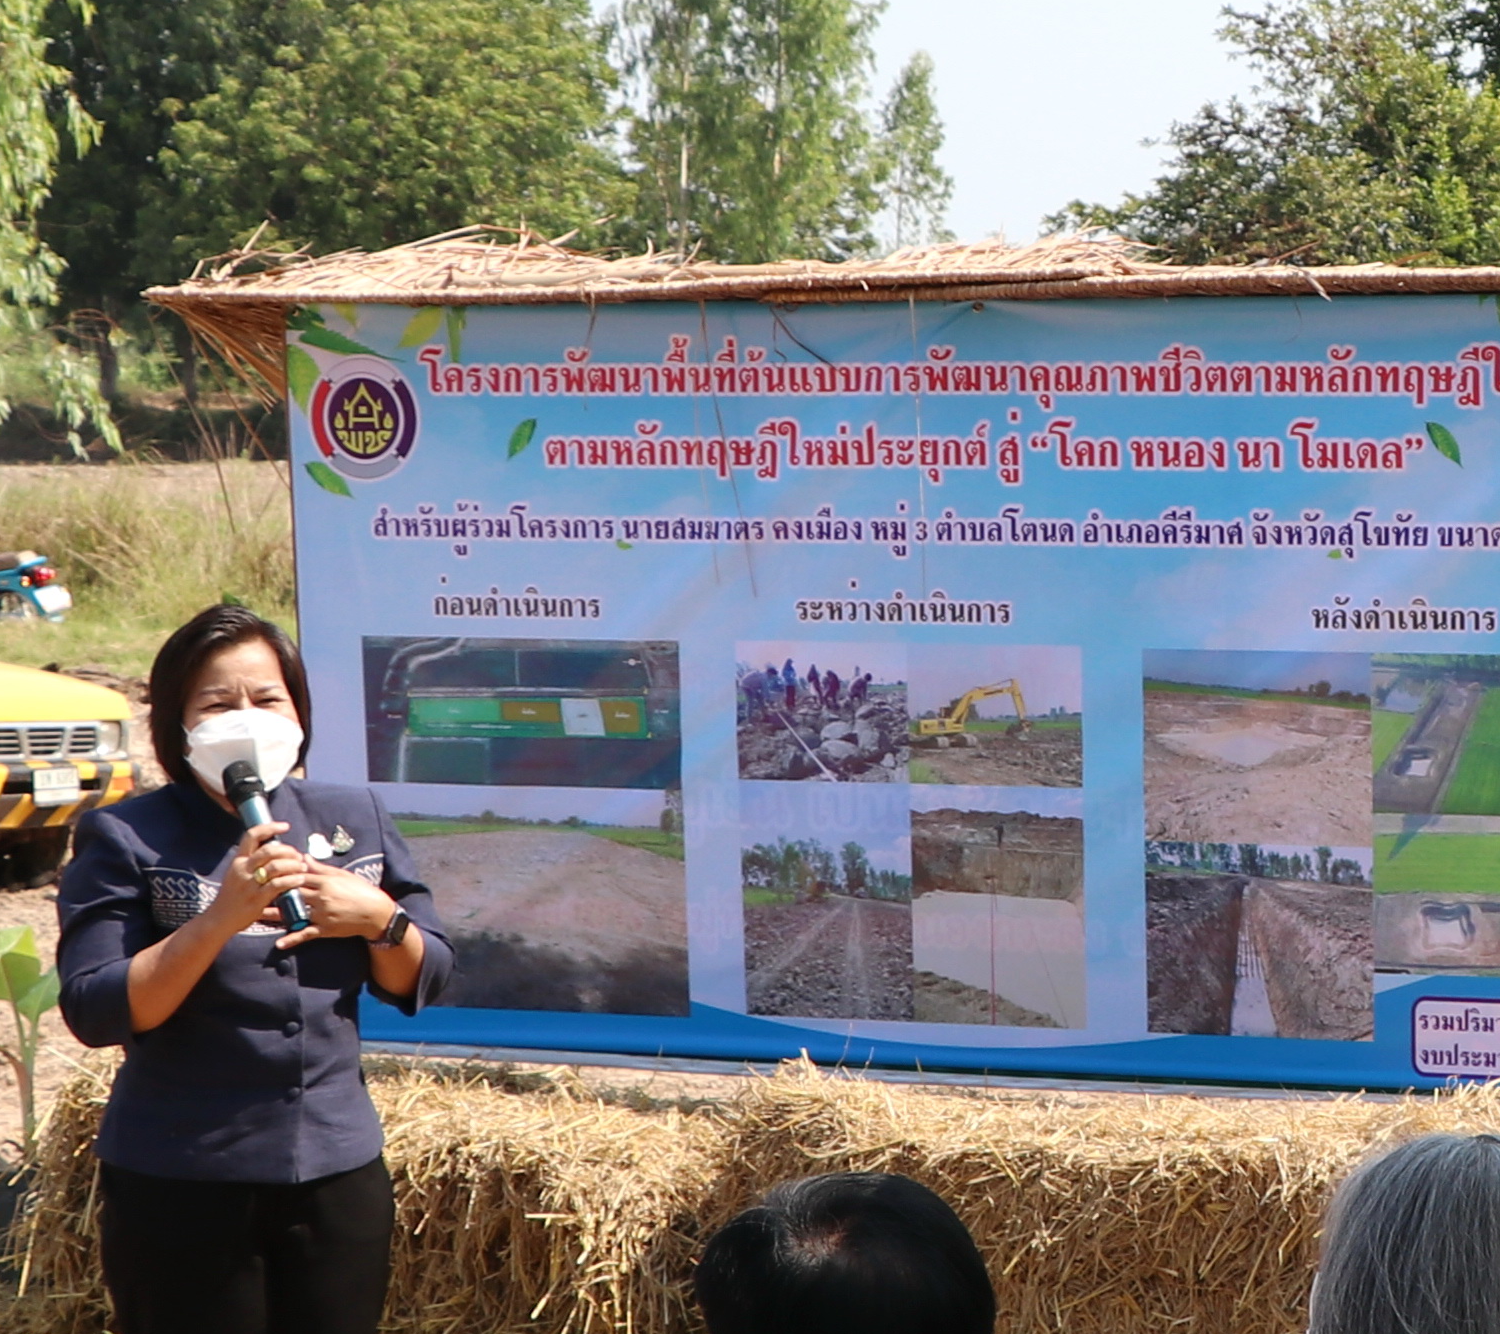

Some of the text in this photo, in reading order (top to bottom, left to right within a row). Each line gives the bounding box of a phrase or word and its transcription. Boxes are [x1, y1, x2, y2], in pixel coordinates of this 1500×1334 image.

[545, 421, 987, 482] ตามหลักทฤษฎีใหม่ประยุกต์
[999, 412, 1021, 483] สู่
[1132, 437, 1225, 468] หนอง
[1238, 438, 1282, 469] นา
[373, 503, 614, 556] สำหรับผู้ร่วมโครงการ
[772, 505, 863, 542] คงเมือง
[871, 503, 907, 557] หมู่
[915, 521, 928, 543] 3
[936, 508, 1075, 543] ตำบลโตนด
[1083, 509, 1244, 545] อำเภอคีรีมาศ
[1252, 512, 1429, 559] จังหวัดสุโขทัย
[434, 576, 600, 618] ก่อนดำเนินการ
[796, 581, 1011, 624] ระหว่างดำเนินการ
[1312, 597, 1496, 631] หลังดำเนินการ
